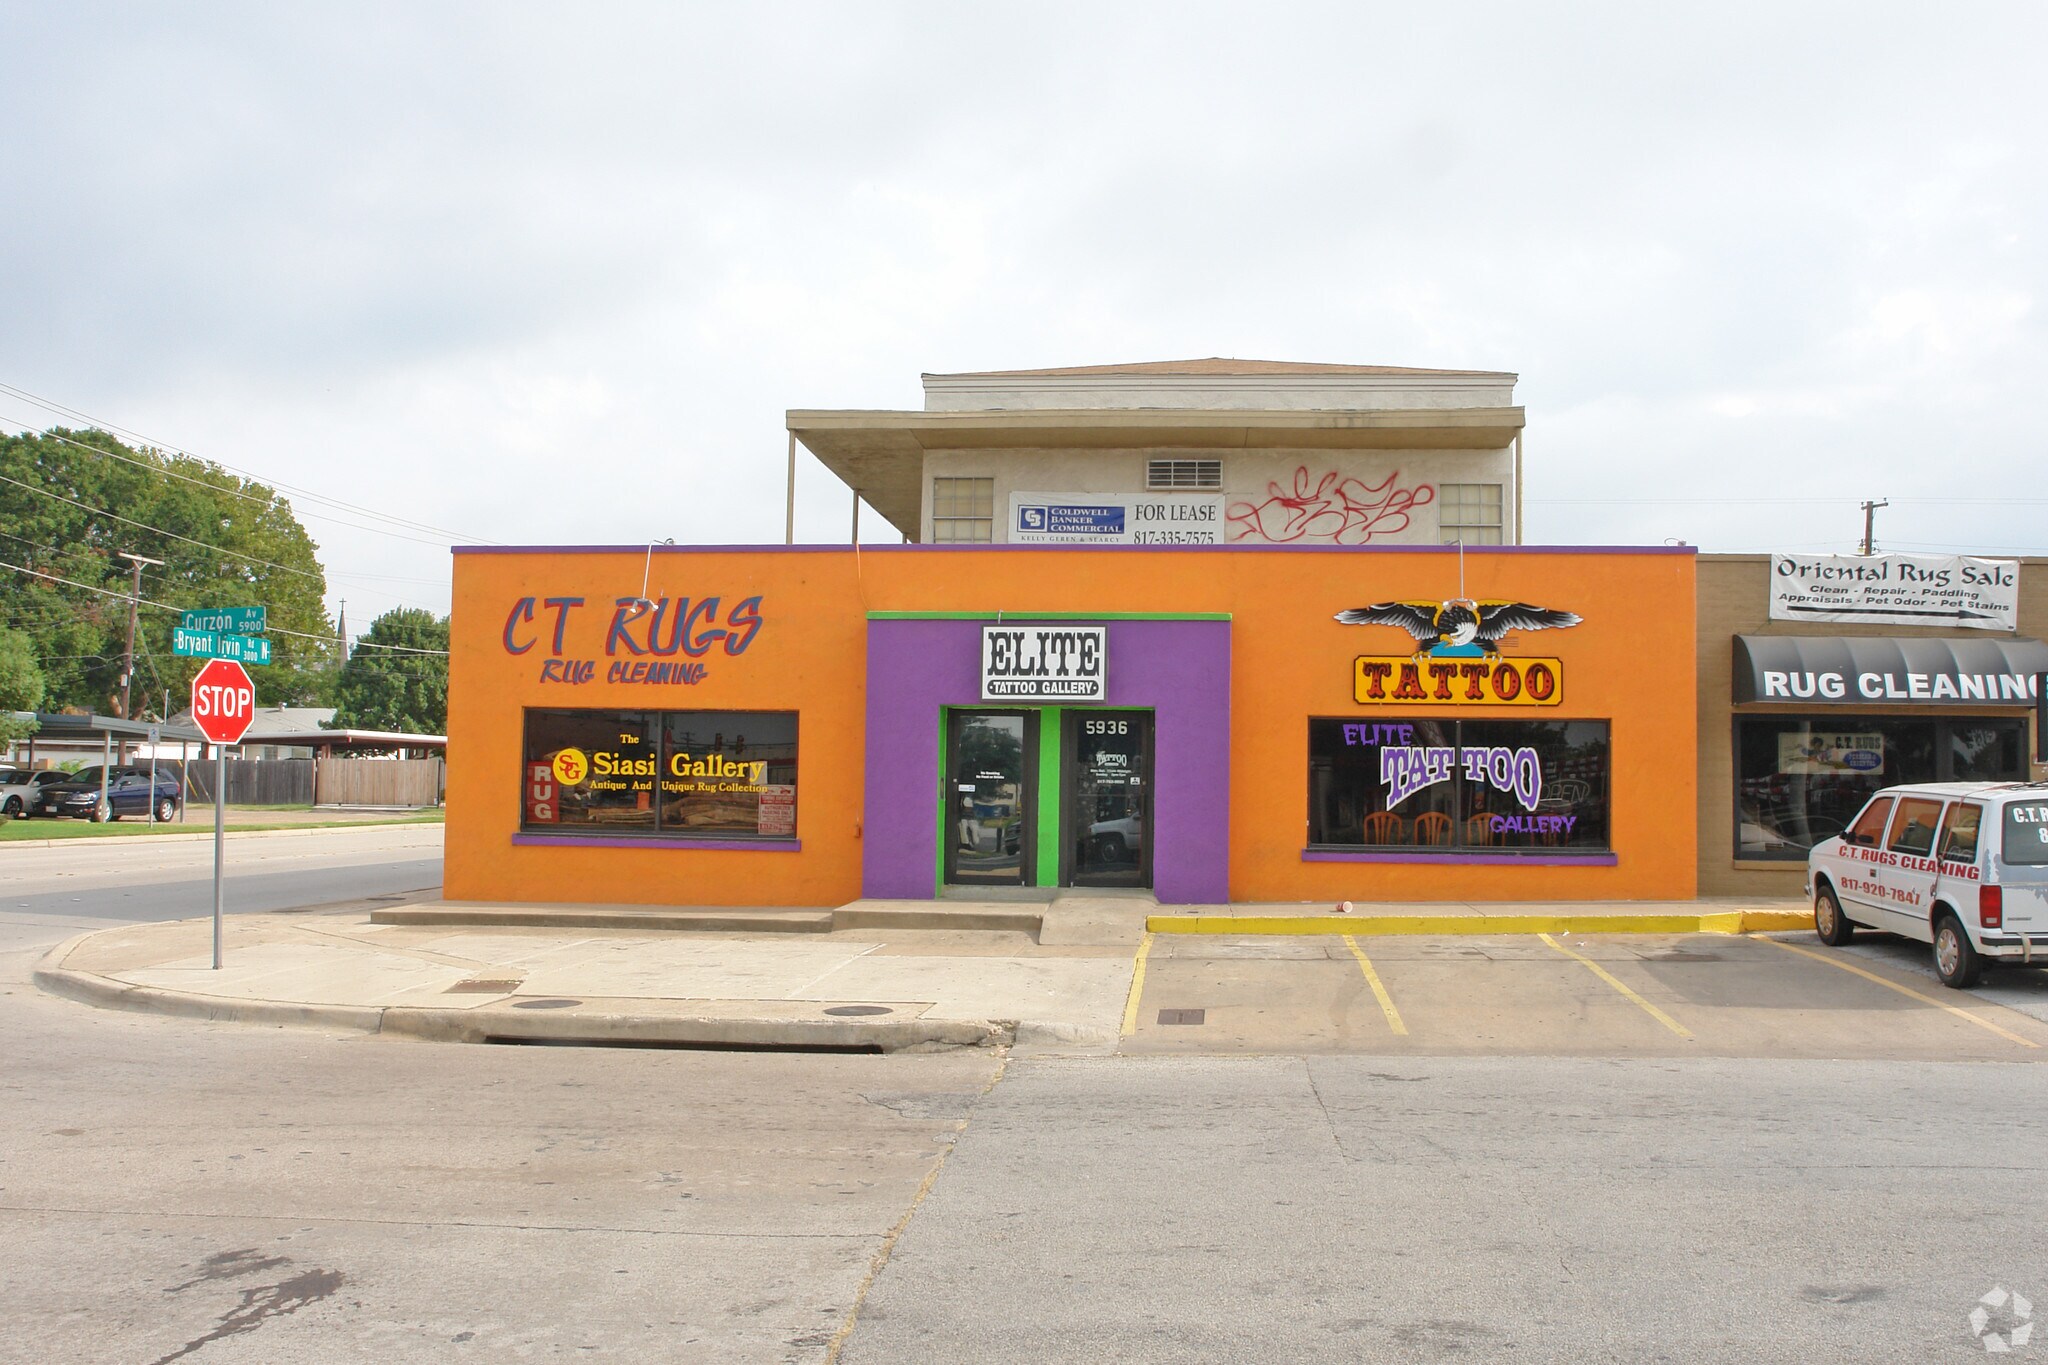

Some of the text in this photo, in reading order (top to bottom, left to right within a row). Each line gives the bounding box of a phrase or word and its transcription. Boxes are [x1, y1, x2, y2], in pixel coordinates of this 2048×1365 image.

[1051, 508, 1110, 516] COLDWELL
[1051, 516, 1093, 524] BANKER
[1135, 504, 1217, 521] FOR LEASE
[1050, 524, 1121, 533] COMMERCIAL
[1133, 530, 1214, 544] 817-335-7575
[1777, 559, 2014, 588] Oriental Rug Sale
[1779, 593, 1853, 604] Appraisals
[1865, 597, 1889, 605] Pet
[1893, 597, 1927, 606] Odor
[1940, 599, 1964, 608] Pet
[1967, 601, 2010, 611] Stains
[1809, 585, 1849, 594] Clean
[1863, 587, 1907, 595] Repair
[1921, 588, 1980, 600] Paddling
[186, 609, 257, 630] Curzon Av
[239, 621, 262, 631] 5900
[502, 595, 764, 658] CT RUGS
[178, 630, 212, 655] Bryant
[217, 635, 240, 656] Irvin
[247, 639, 255, 648] Rd
[987, 632, 1100, 676] ELITE
[539, 659, 709, 685] RUG CLEANING
[1362, 661, 1555, 701] TATTOO
[993, 681, 1093, 694] TATTOO GALLERY
[1763, 671, 1846, 698] RUG
[197, 684, 251, 718] STOP
[1086, 720, 1128, 735] 5936
[1342, 723, 1414, 746] ELITE
[619, 734, 640, 745] The
[1835, 736, 1853, 749] C.T.
[593, 751, 765, 782] Siasi Gallery
[589, 780, 768, 793] Antique And Unique Rug Collection
[1380, 745, 1542, 812] TATTOO
[533, 765, 552, 819] RUG
[1489, 815, 1578, 834] GALLERY
[2012, 807, 2039, 823] C.T.
[1839, 845, 1980, 880] C.T. RUGS CLEANING
